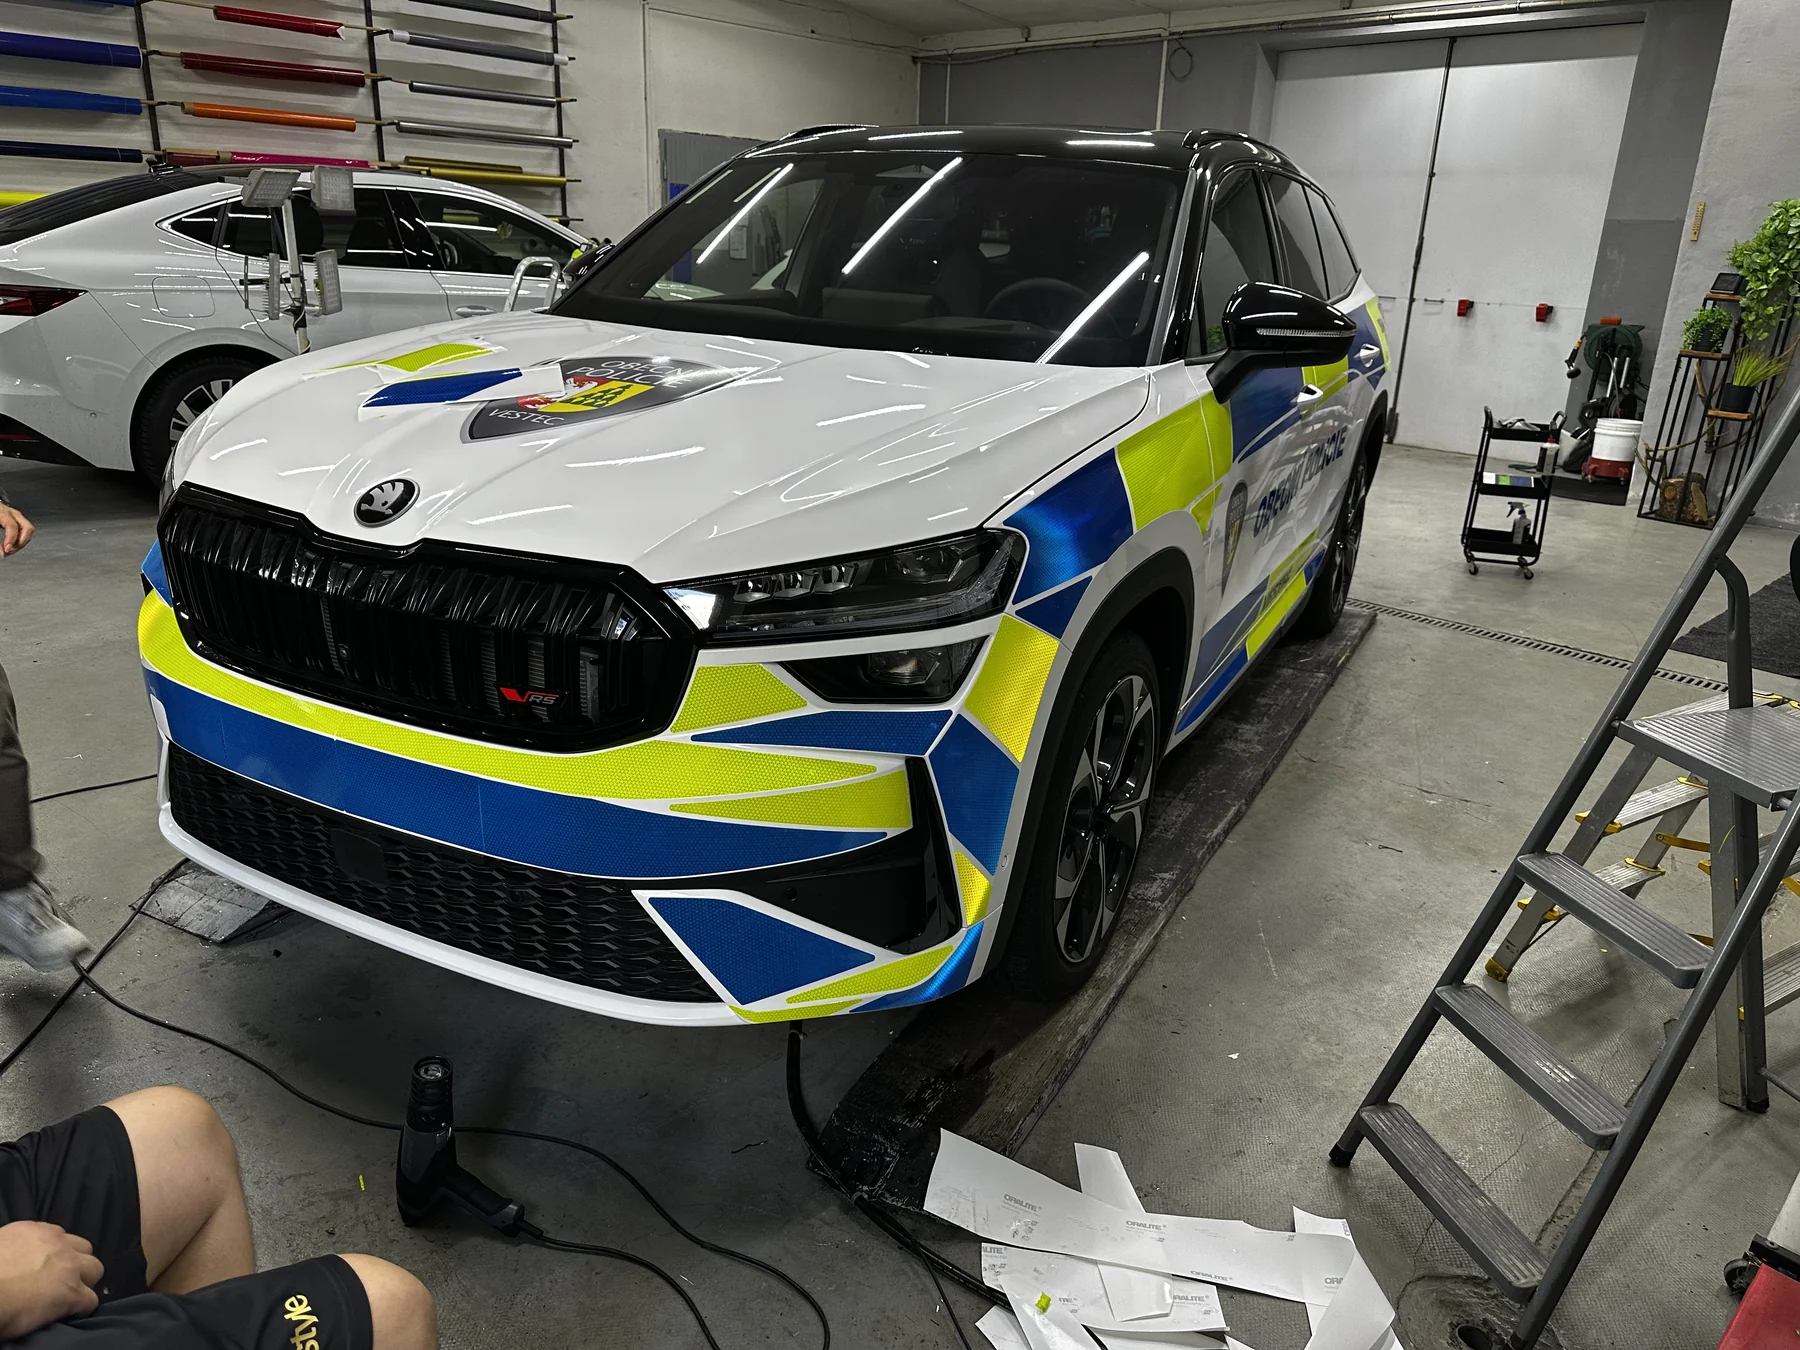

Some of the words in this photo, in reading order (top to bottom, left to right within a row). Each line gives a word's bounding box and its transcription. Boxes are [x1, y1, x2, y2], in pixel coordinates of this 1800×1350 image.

[601, 360, 694, 377] OBECN
[488, 408, 565, 425] VESTEC
[1173, 1294, 1205, 1302] RALITE
[284, 1295, 320, 1350] style
